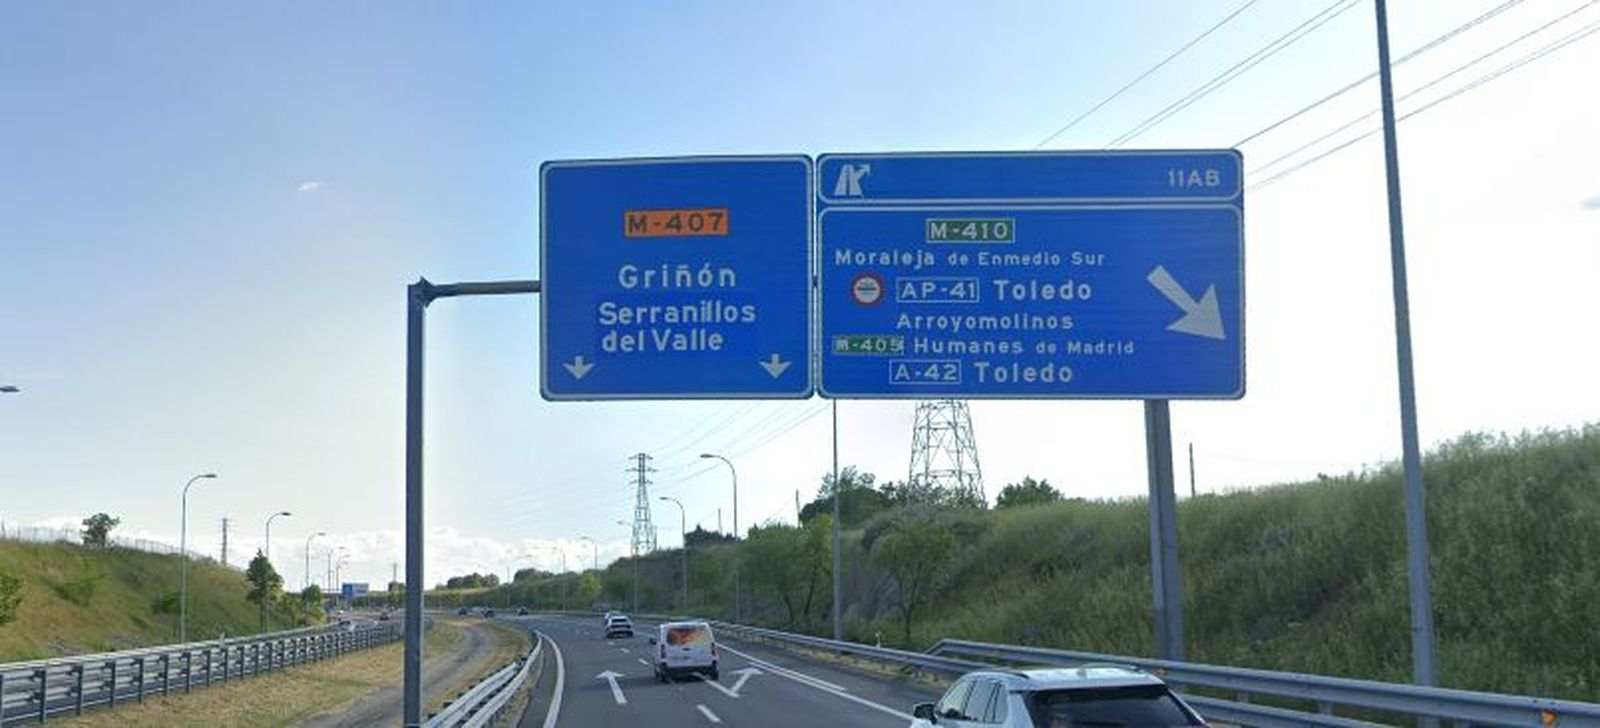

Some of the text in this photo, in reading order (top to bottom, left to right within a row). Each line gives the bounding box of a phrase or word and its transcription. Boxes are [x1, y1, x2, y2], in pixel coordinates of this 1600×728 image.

[1167, 169, 1221, 187] 11AB
[628, 212, 724, 233] M-407
[930, 222, 1009, 240] M-410
[835, 249, 1106, 269] Moraleja de Enmedio Sur
[618, 262, 737, 288] Griñón
[900, 281, 977, 301] AP-41
[993, 279, 1093, 301] Toledo
[598, 300, 757, 325] Serranillos
[896, 312, 1074, 333] Arroyomolinos
[601, 328, 724, 352] del Valle
[914, 337, 1023, 354] Humanes
[1036, 341, 1057, 354] de
[1067, 340, 1136, 354] Madrid
[894, 362, 1074, 384] A-42 Toledo
